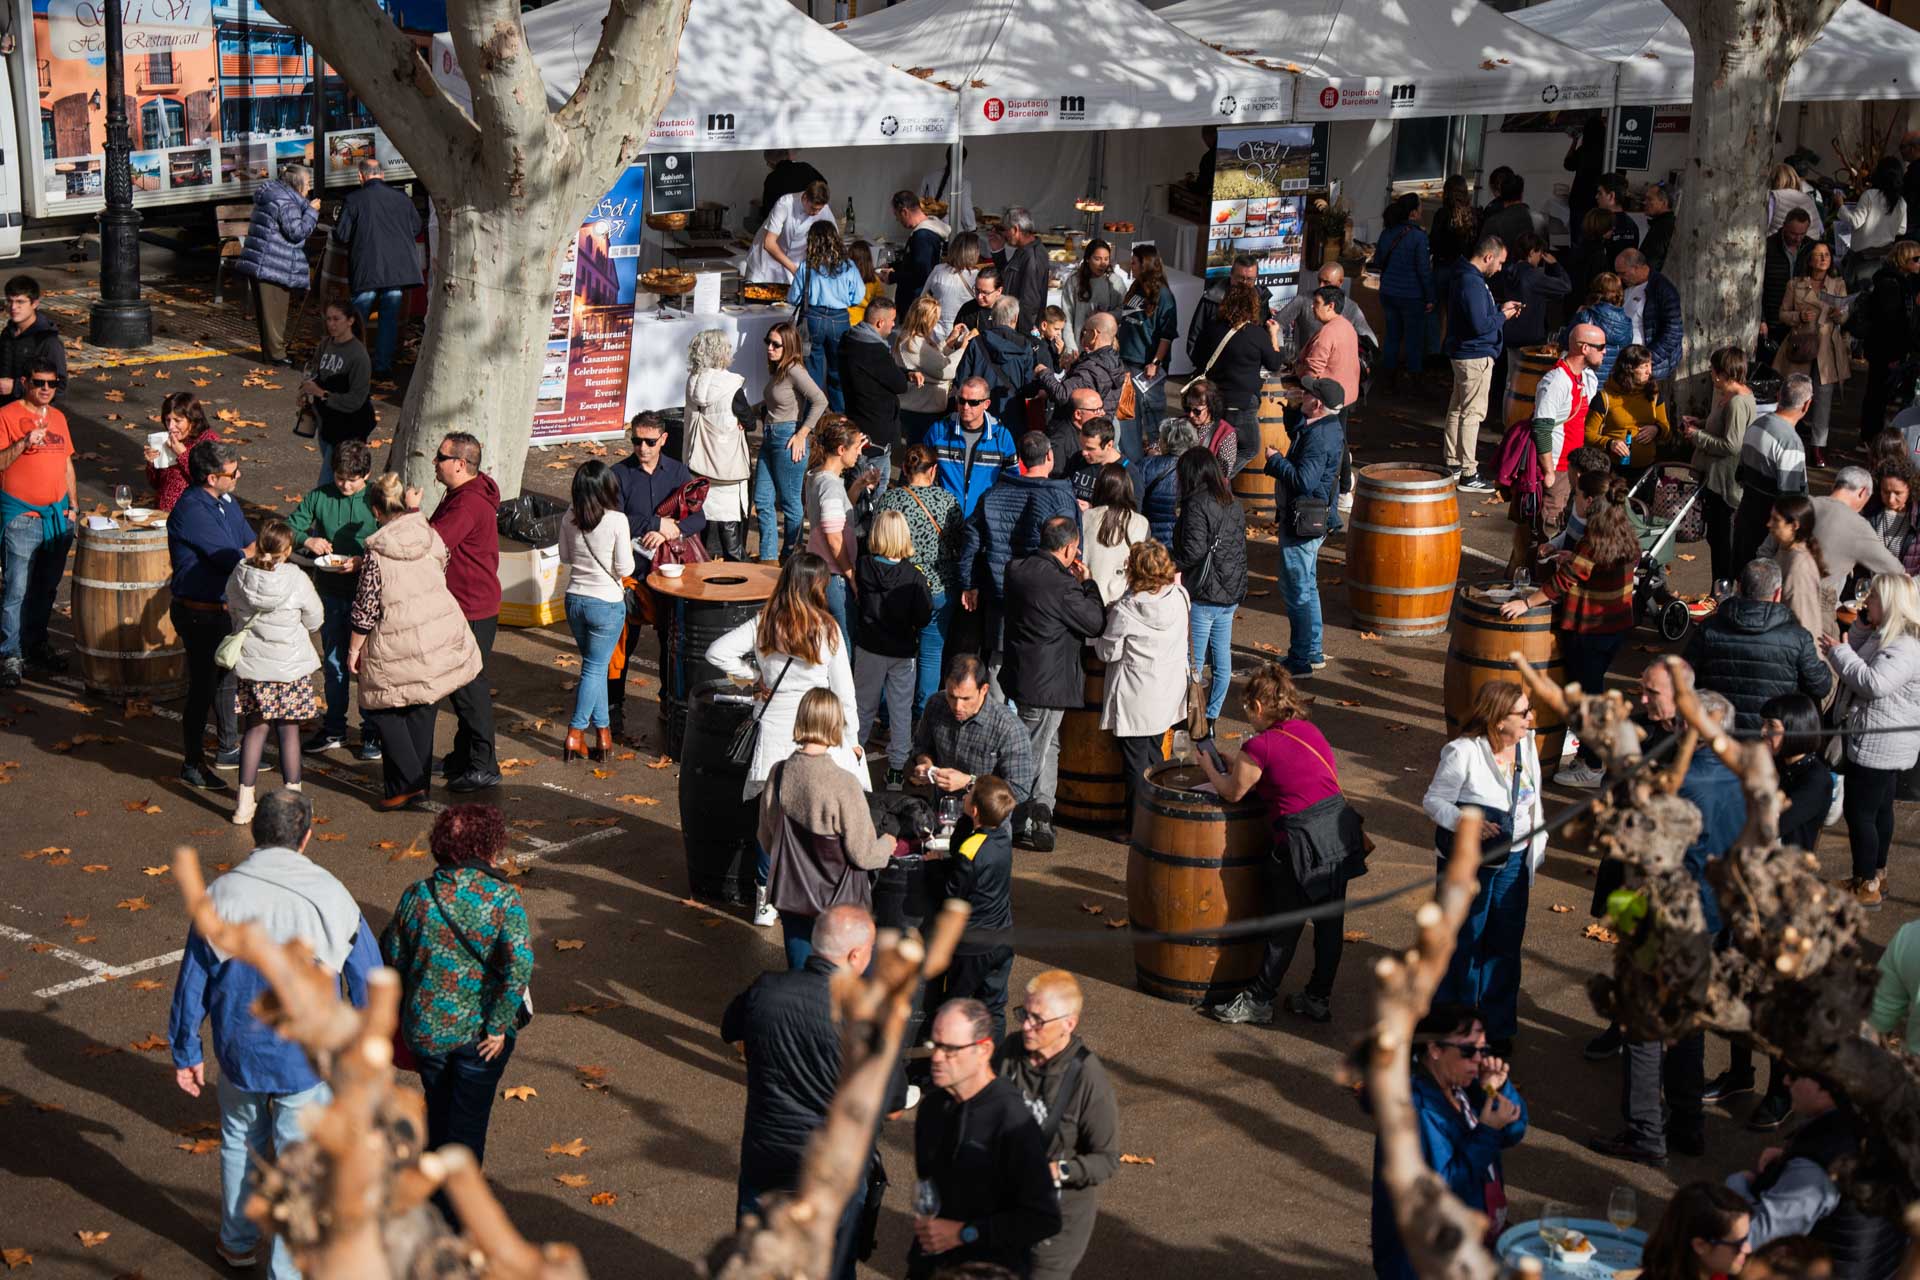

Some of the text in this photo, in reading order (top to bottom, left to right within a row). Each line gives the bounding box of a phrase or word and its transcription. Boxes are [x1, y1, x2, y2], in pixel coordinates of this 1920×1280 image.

[124, 31, 200, 49] Restaurant
[1008, 100, 1048, 109] Diputació
[1341, 98, 1378, 106] Barcelona
[1008, 109, 1048, 117] Barcelona
[656, 119, 695, 128] iputació
[1237, 140, 1281, 161] Sol
[588, 197, 638, 218] Sol i
[582, 331, 626, 340] Restaurant
[603, 341, 625, 350] Hotel
[582, 354, 624, 363] Casaments
[320, 353, 344, 374] GAP
[574, 365, 623, 375] Celebracions
[585, 377, 622, 387] Reunions
[594, 388, 621, 397] Events
[579, 400, 620, 411] Escapades
